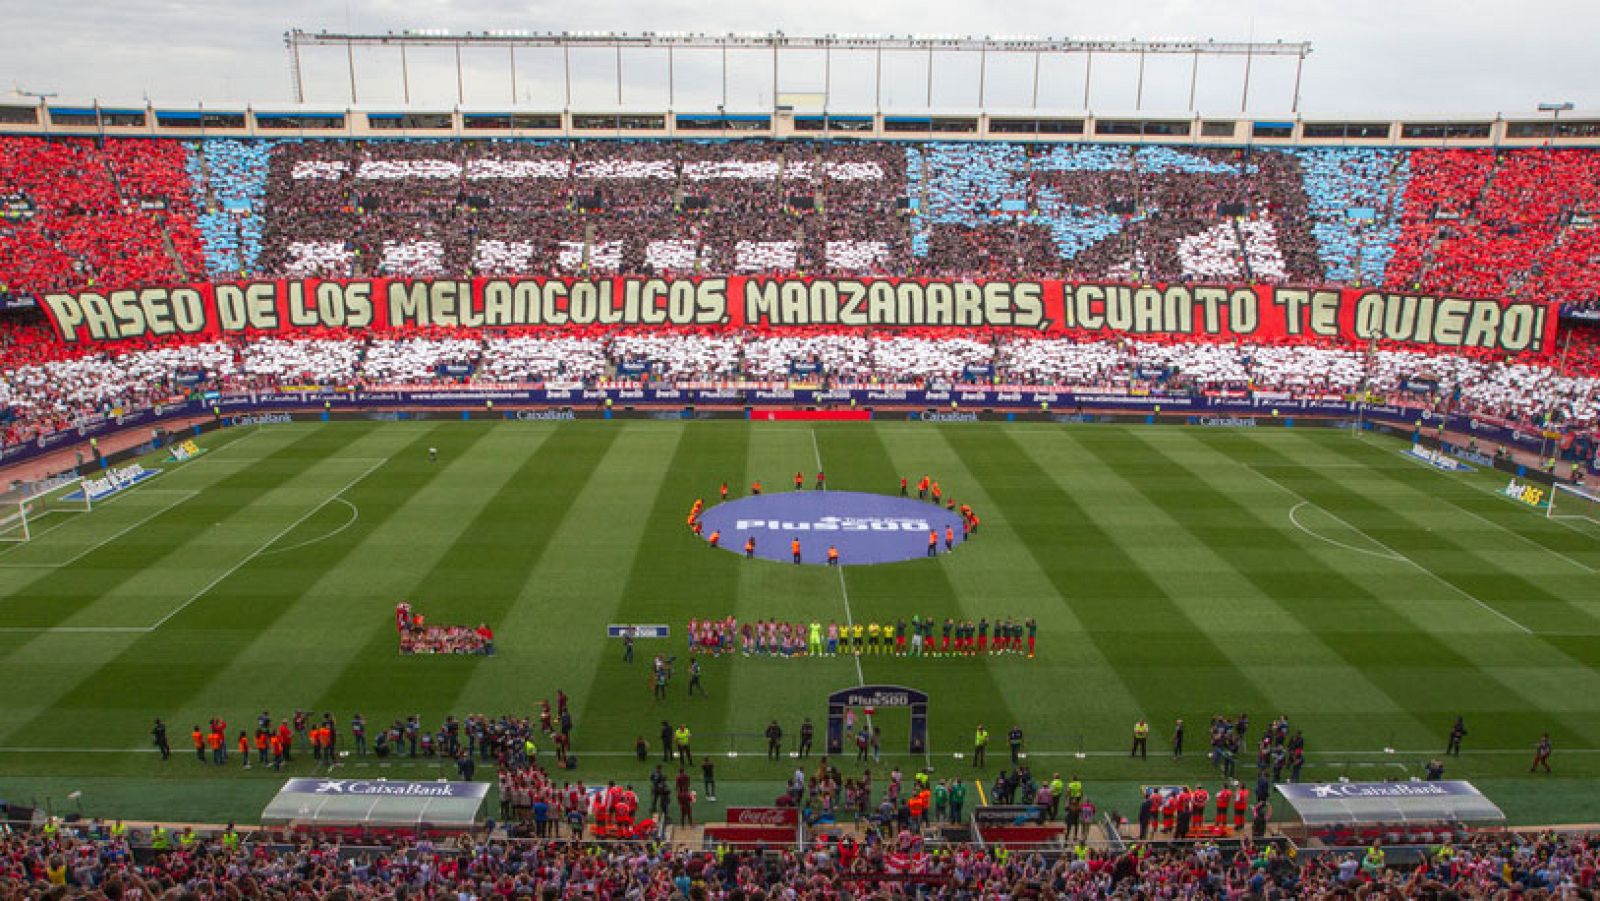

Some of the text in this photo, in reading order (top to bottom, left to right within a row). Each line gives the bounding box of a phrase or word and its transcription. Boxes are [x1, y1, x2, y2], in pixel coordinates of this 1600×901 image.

[44, 288, 205, 341] PASEO
[215, 283, 278, 330] DE
[287, 281, 373, 328] LOS
[745, 280, 1051, 330] MANZANARES,
[1274, 286, 1339, 335] TE
[1356, 292, 1546, 351] QUIERO!
[736, 519, 929, 531] Plus500
[848, 695, 909, 705] Plus500
[349, 781, 454, 796] CaixaBank
